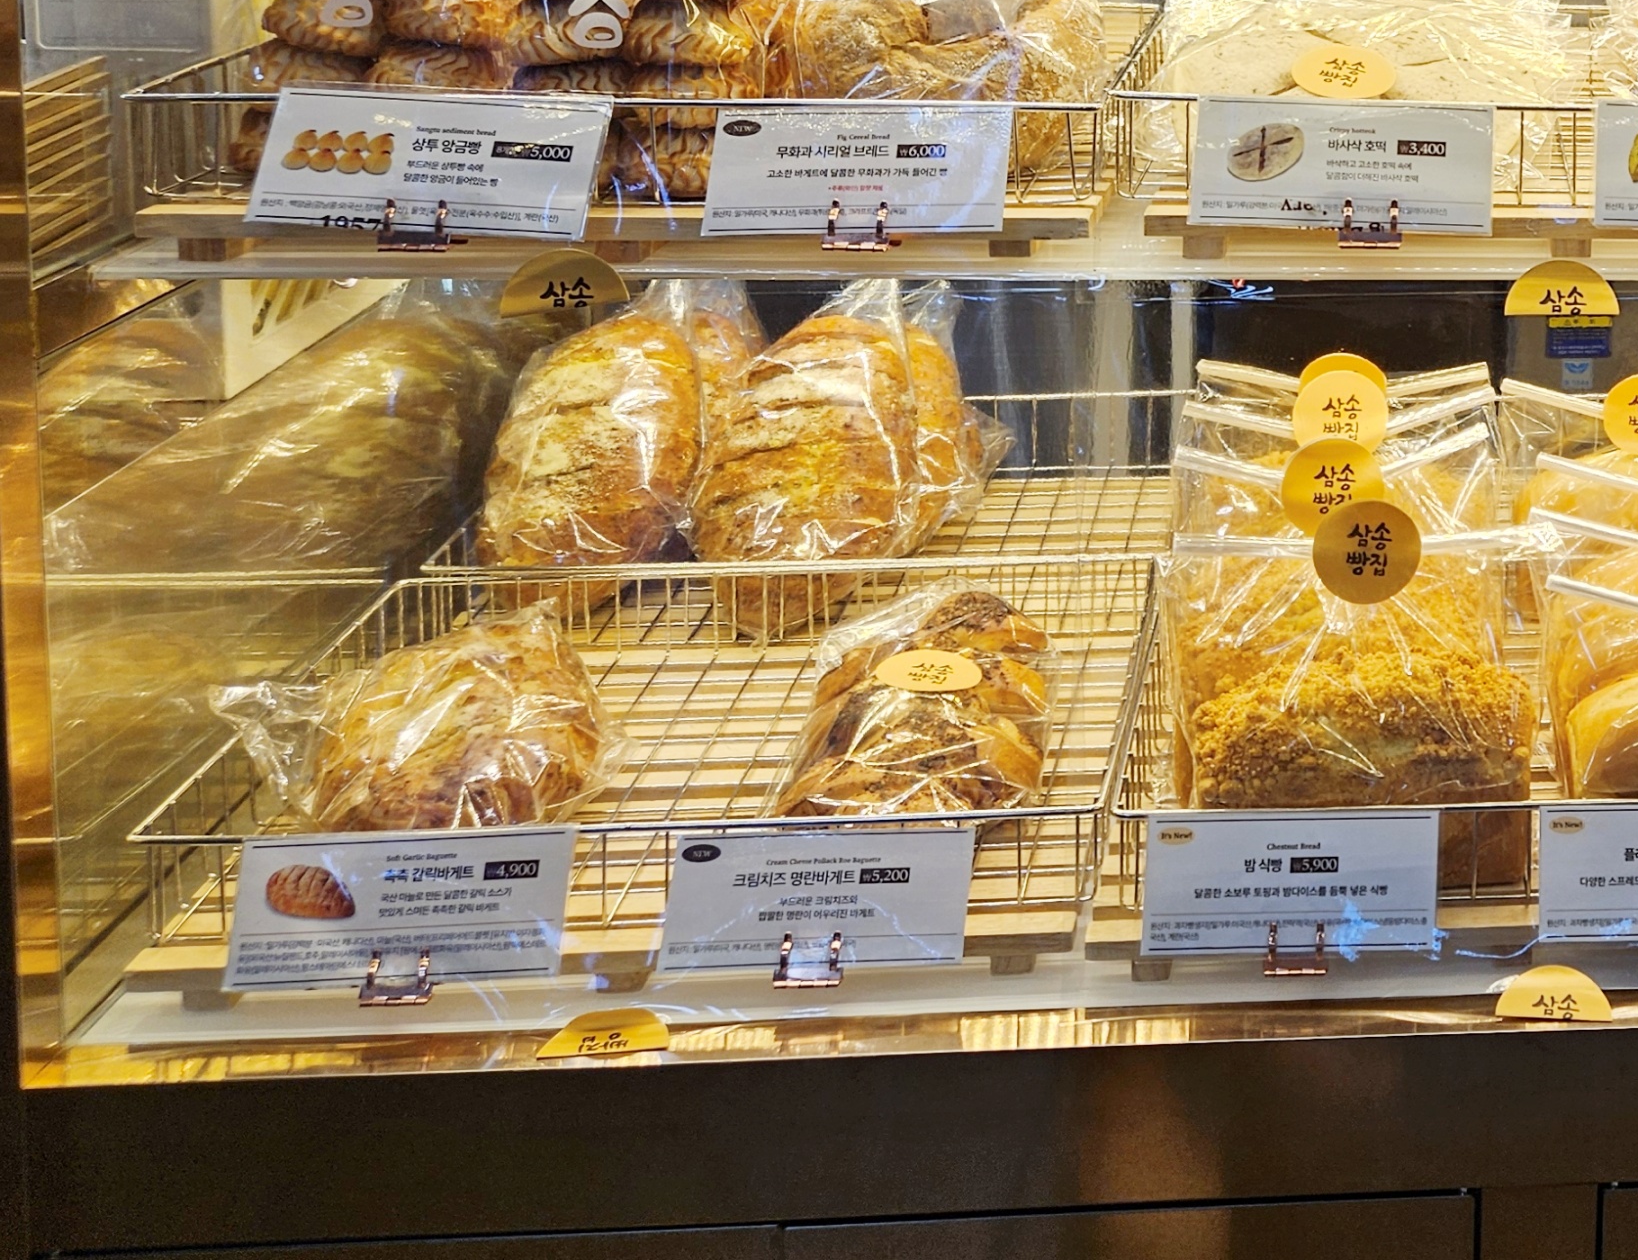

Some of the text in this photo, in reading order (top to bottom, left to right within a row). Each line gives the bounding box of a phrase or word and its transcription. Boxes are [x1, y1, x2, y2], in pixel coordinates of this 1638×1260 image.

[1325, 57, 1366, 75] 삼송
[1319, 70, 1358, 87] 빵집
[412, 138, 439, 152] 상투
[441, 139, 481, 155] 앙금빵
[776, 144, 945, 159] 무화과 시리얼 브레드 ₩6,000
[1328, 138, 1445, 156] 바사삭 호떡 ₩3,400
[1358, 160, 1379, 170] 고소한
[767, 168, 937, 178] 고소한 바게트에 달콤한 무화과가 가득 들어간
[540, 276, 594, 309] 삼송
[1539, 285, 1587, 315] 삼송
[1322, 394, 1362, 421] 삼송
[1313, 464, 1356, 491] 삼송
[1346, 522, 1393, 551] 삼송
[1346, 547, 1390, 578] 빵집
[1552, 821, 1564, 829] It's
[1161, 832, 1173, 840] It's
[1267, 842, 1321, 851] Chestnut Bread
[403, 853, 425, 861] Garlic
[427, 852, 458, 862] Baguette
[813, 857, 837, 866] Pollack
[852, 856, 881, 866] Baguette
[1245, 859, 1257, 872] 밤
[1259, 858, 1282, 872] 식빵
[412, 865, 474, 881] 갈릭바게트
[733, 869, 909, 888] 크림치즈 명란바게트 ₩5,200
[1580, 876, 1606, 887] 다양한
[1194, 884, 1388, 899] 달콤한 소보루 토핑과 밤다이스를 식빵
[476, 903, 500, 913] 바게트
[779, 895, 858, 907] 부드러운 크림치즈와
[785, 908, 875, 920] 명란이 어우러진 바게트
[1532, 992, 1581, 1020] 삼송
